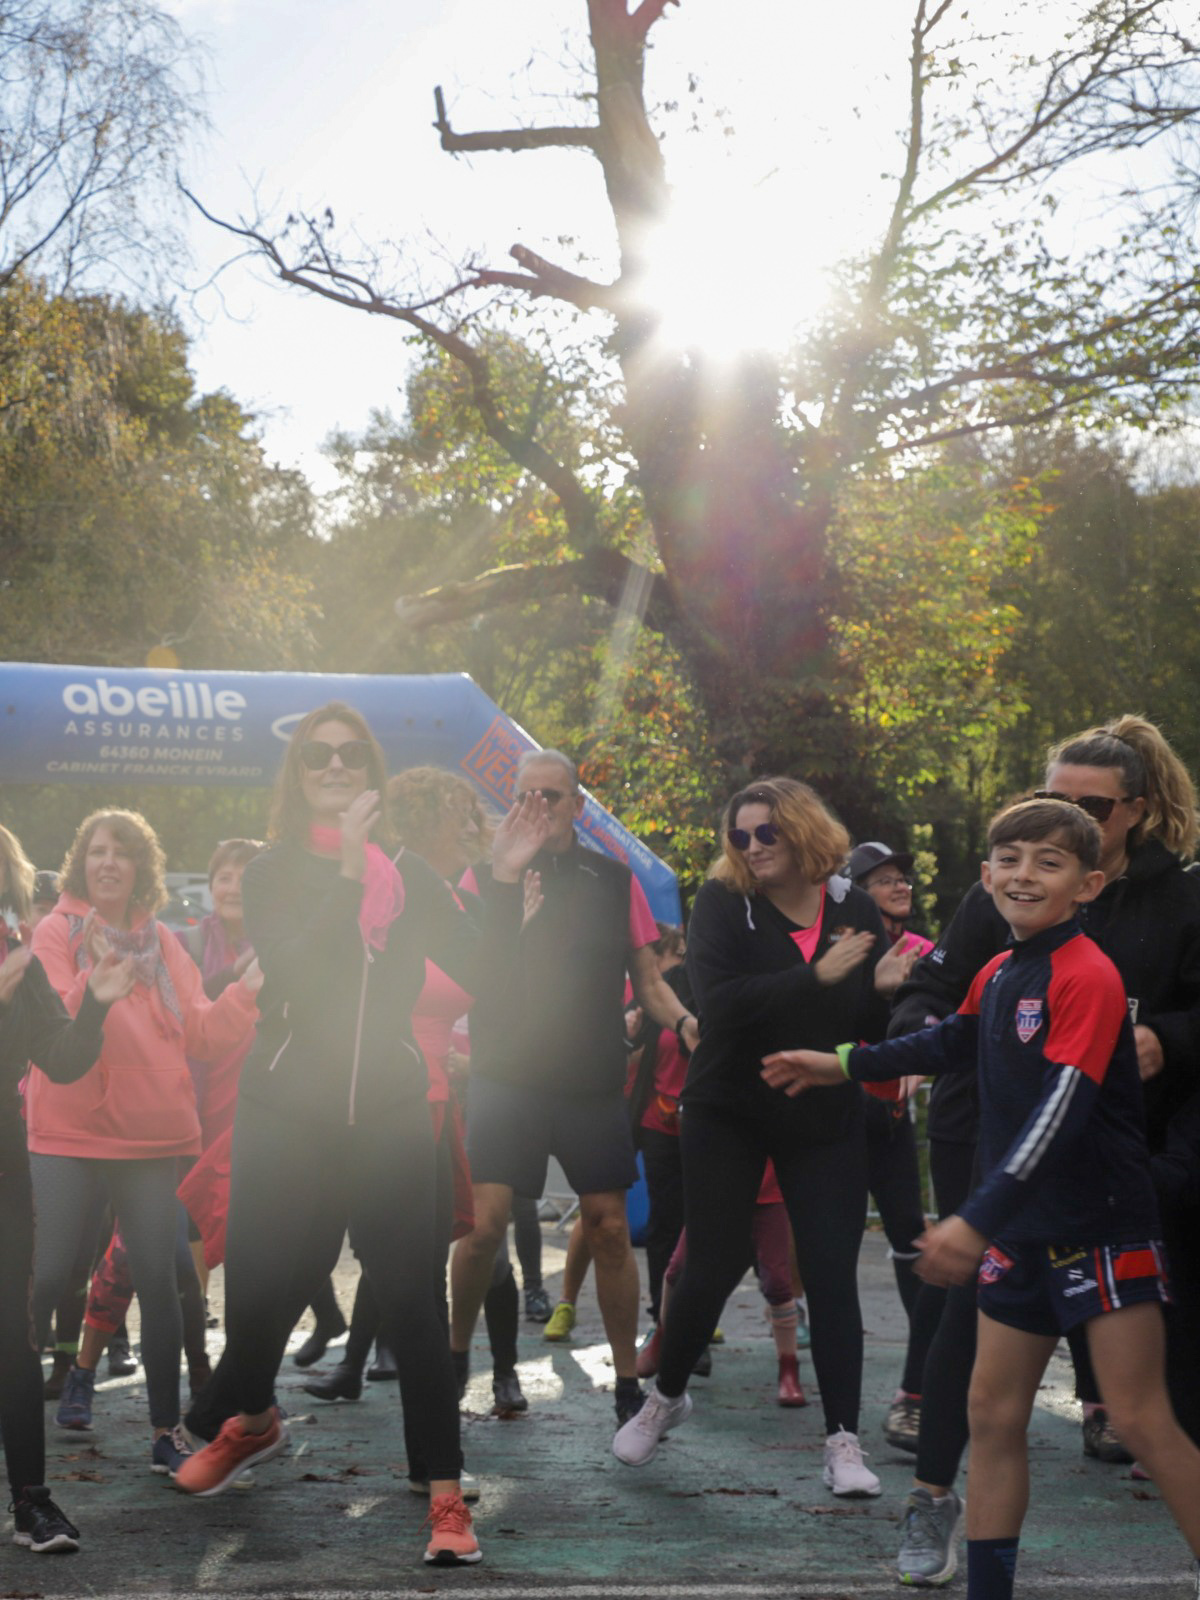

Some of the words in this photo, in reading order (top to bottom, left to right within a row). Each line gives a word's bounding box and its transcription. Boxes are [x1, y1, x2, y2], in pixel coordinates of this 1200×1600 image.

[62, 678, 247, 720] abeille
[64, 720, 244, 742] ASSURANCES
[100, 745, 150, 760] 64360
[153, 747, 224, 762] MONEIN
[45, 760, 120, 774] CABINET
[123, 762, 192, 776] FRANCK
[194, 765, 263, 777] EVRARD
[473, 740, 518, 799] VER
